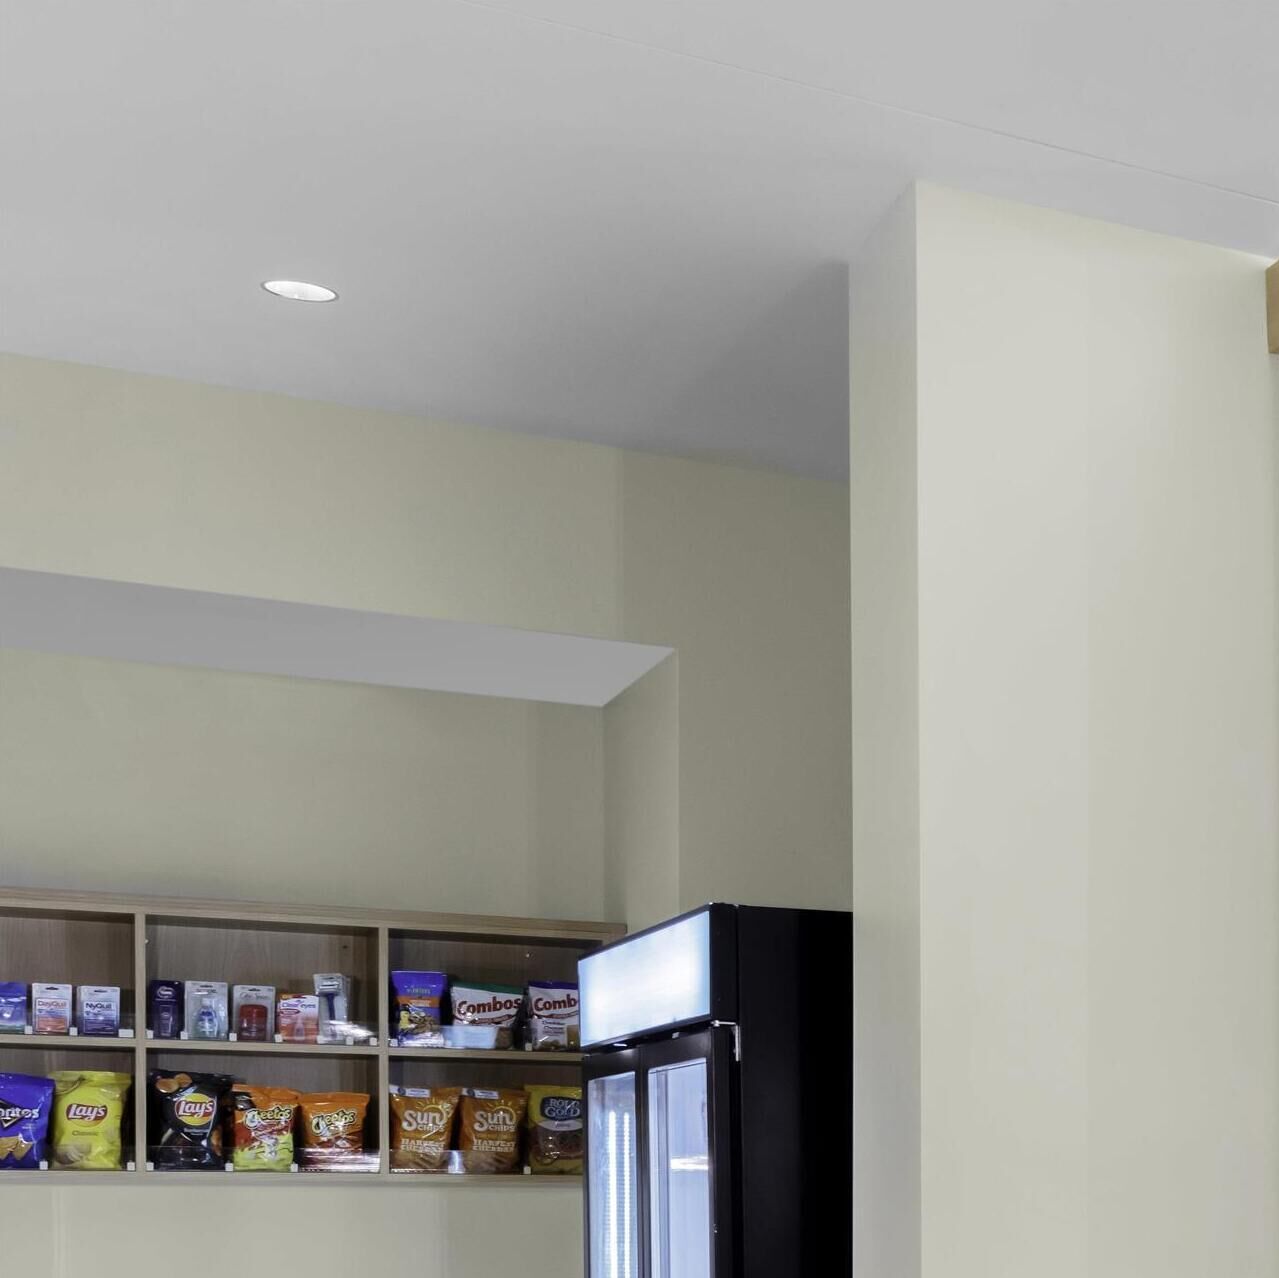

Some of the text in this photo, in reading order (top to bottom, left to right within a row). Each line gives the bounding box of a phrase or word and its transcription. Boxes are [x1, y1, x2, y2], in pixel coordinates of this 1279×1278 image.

[38, 1000, 67, 1009] DayQuil
[85, 1002, 112, 1011] NyQuil
[301, 1003, 316, 1011] eyes
[457, 995, 521, 1016] Combos
[534, 994, 577, 1012] Comb
[68, 1104, 105, 1121] Lay's
[177, 1099, 214, 1117] Lay's
[244, 1106, 291, 1129] Cheetos
[312, 1110, 355, 1136] Cheetos
